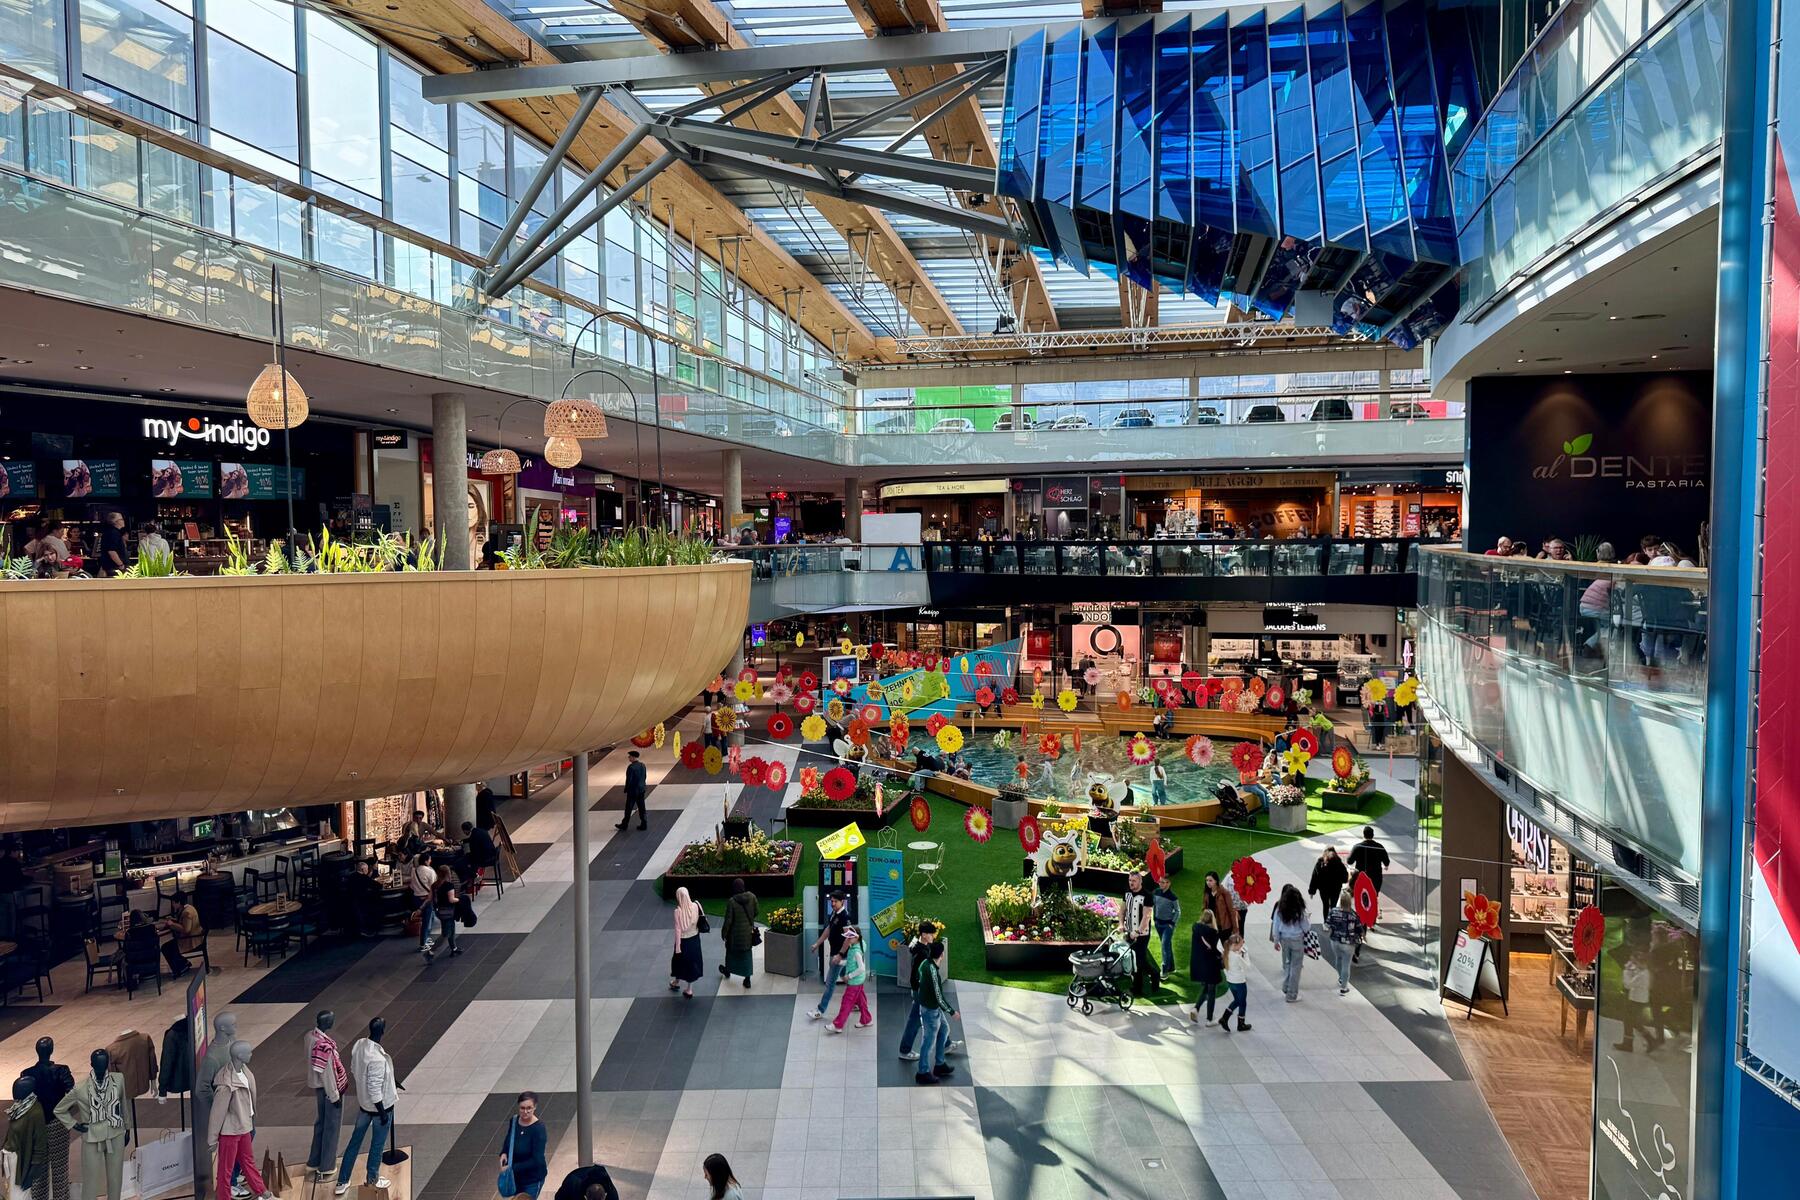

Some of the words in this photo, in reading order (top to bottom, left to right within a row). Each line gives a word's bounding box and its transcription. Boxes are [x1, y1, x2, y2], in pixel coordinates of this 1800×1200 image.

[1532, 454, 1565, 479] al
[1570, 454, 1705, 478] DENTE
[1193, 475, 1263, 487] BELLAGGIO
[1625, 480, 1705, 489] PASTARIA
[918, 606, 940, 618] Kneipp
[884, 675, 915, 693] ZEHNER
[820, 833, 840, 847] ZEHNER
